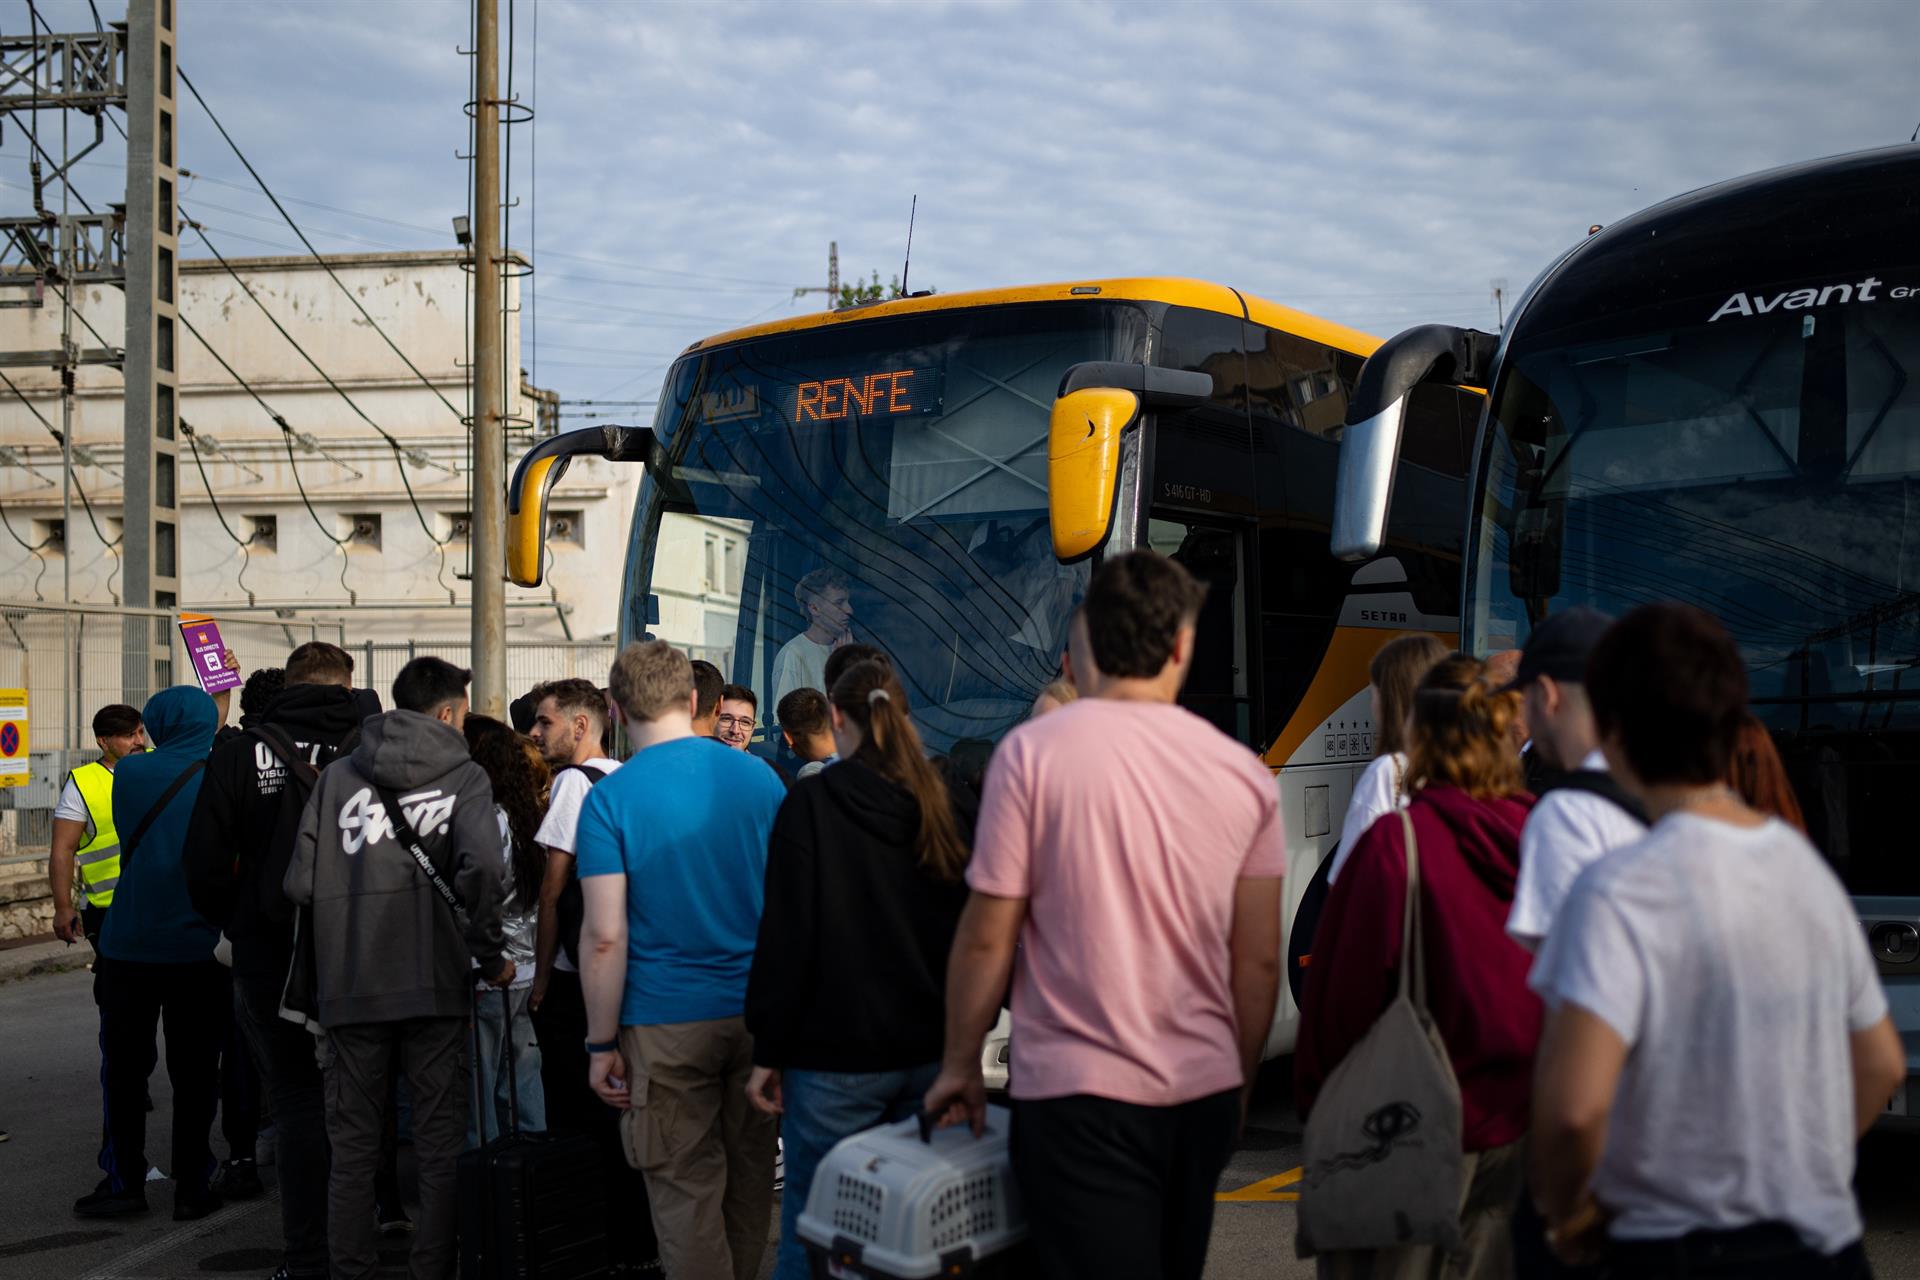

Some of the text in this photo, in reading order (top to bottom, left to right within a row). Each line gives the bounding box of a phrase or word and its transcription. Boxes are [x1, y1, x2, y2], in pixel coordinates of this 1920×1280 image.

[1707, 277, 1882, 322] Avant
[795, 370, 913, 422] RENFE
[1361, 610, 1407, 623] SETRA
[257, 769, 288, 779] VISU
[257, 778, 286, 788] LOS ANGEL
[410, 843, 456, 904] umbro umbro
